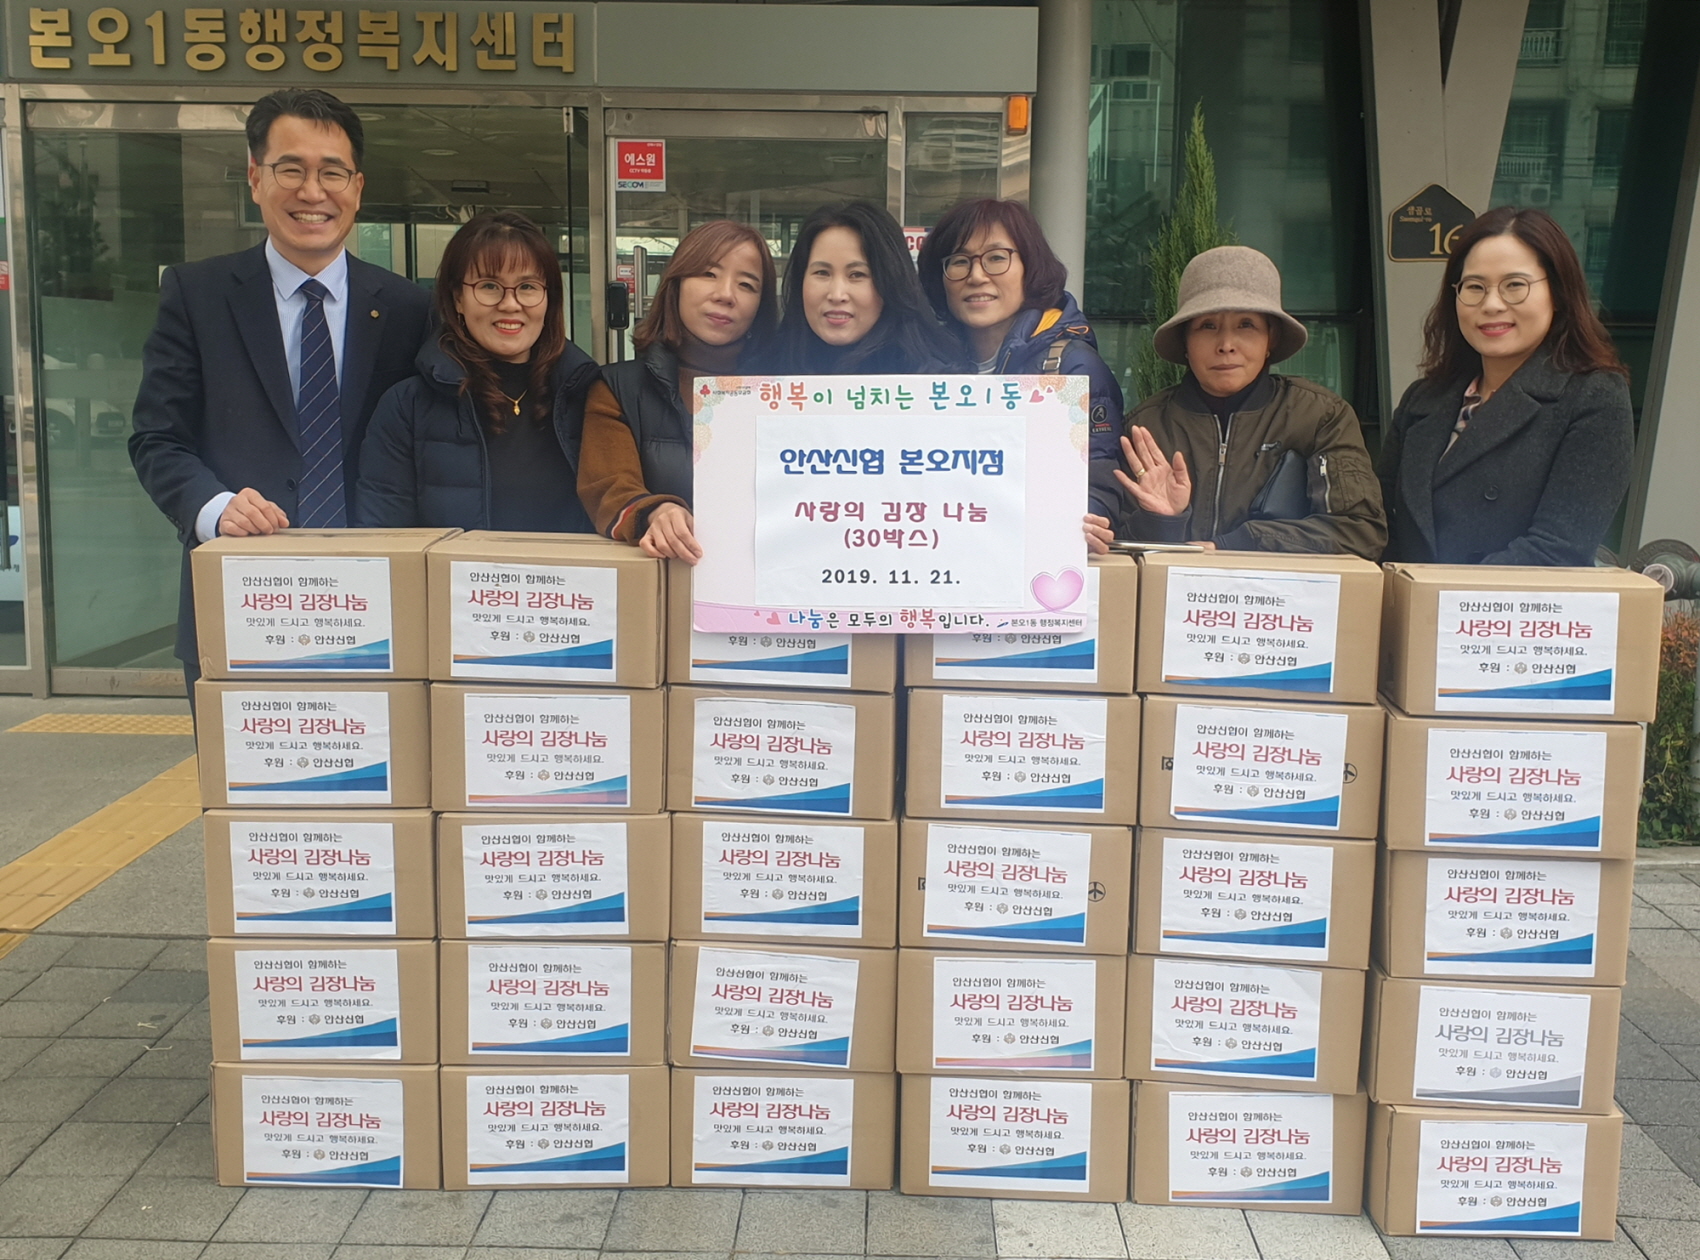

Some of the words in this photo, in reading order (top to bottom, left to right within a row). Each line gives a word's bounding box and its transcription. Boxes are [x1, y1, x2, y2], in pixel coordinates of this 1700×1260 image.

[624, 153, 656, 166] 에스원
[759, 381, 832, 412] 행복이
[847, 385, 914, 410] 넘치는
[929, 382, 1022, 410] 본오1동
[780, 448, 884, 475] 안산신협
[899, 449, 1003, 475] 본오지점
[795, 502, 864, 522] 사랑의
[881, 502, 927, 522] 김장
[944, 502, 987, 522] 나눔
[844, 528, 938, 549] (30박스)
[241, 577, 292, 587] 안산신협이
[298, 577, 339, 587] 함께하는
[469, 573, 520, 584] 안산신협이
[526, 575, 566, 586] 함께하는
[822, 569, 876, 584] 2019.
[889, 570, 918, 584] 11.
[930, 570, 960, 584] 21.
[240, 594, 292, 610] 사랑의
[299, 594, 368, 611] 김장나눔
[467, 589, 519, 608] 사랑의
[526, 592, 594, 610] 김장나눔
[1186, 593, 1238, 605] 안산신협이
[1244, 595, 1286, 607] 함께하는
[1459, 602, 1514, 613] 안산신협이
[1519, 603, 1563, 613] 함께하는
[788, 610, 839, 629] 나눔은
[848, 613, 892, 627] 모두의
[900, 610, 990, 629] 행복입니다.
[1011, 619, 1037, 627] 본오1동
[1040, 619, 1082, 627] 행정복지센터
[1182, 609, 1236, 628] 사랑의
[1244, 613, 1314, 632] 김장나눔
[1455, 620, 1511, 638] 사랑의
[1519, 620, 1593, 638] 김장나눔
[728, 635, 748, 646] 후원
[776, 638, 816, 649] 안산신협
[972, 633, 992, 643] 후원
[1021, 634, 1062, 644] 안산신협
[241, 702, 291, 711] 안산신협이
[297, 702, 337, 711] 함께하는
[240, 718, 291, 734] 사랑의
[298, 718, 366, 734] 김장나눔
[713, 717, 762, 728] 안산신협이
[767, 719, 806, 730] 함께하는
[482, 730, 533, 747] 사랑의
[540, 730, 608, 747] 김장나눔
[960, 730, 1011, 748] 사랑의
[1018, 732, 1085, 750] 김장나눔
[1196, 724, 1248, 737] 안산신협이
[1253, 728, 1295, 740] 함께하는
[710, 733, 760, 751] 사랑의
[767, 736, 833, 755] 김장나눔
[554, 755, 604, 763] 행복하세요.
[965, 754, 993, 763] 맛있게
[998, 755, 1026, 764] 드시고
[1031, 756, 1081, 766] 행복하세요.
[1192, 741, 1245, 761] 사랑의
[1253, 746, 1322, 766] 김장나눔
[1446, 766, 1501, 784] 사랑의
[1509, 768, 1582, 786] 김장나눔
[1451, 791, 1481, 800] 맛있게
[1487, 792, 1517, 800] 드시고
[1523, 793, 1576, 803] 행복하세요.
[481, 835, 531, 845] 안산신협이
[536, 834, 576, 844] 함께하는
[247, 849, 298, 865] 사랑의
[304, 849, 371, 865] 김장나눔
[479, 851, 530, 868] 사랑의
[537, 849, 604, 867] 김장나눔
[718, 849, 768, 866] 사랑의
[775, 850, 841, 868] 김장나눔
[947, 844, 996, 856] 안산신협이
[1002, 847, 1041, 859] 함께하는
[319, 873, 368, 881] 행복하세요.
[723, 872, 751, 880] 맛있게
[756, 873, 783, 881] 드시고
[788, 874, 837, 884] 행복하세요.
[943, 860, 994, 879] 사랑의
[1001, 864, 1068, 884] 김장나눔
[1179, 866, 1231, 885] 사랑의
[1239, 869, 1308, 889] 김장나눔
[1447, 870, 1500, 880] 안산신협이
[1505, 871, 1547, 881] 함께하는
[1184, 890, 1213, 899] 맛있게
[1218, 892, 1246, 901] 드시고
[1252, 894, 1303, 905] 행복하세요.
[1444, 886, 1497, 904] 사랑의
[1505, 888, 1575, 905] 김장나눔
[253, 960, 302, 970] 안산신협이
[308, 960, 347, 969] 함께하는
[253, 976, 303, 992] 사랑의
[309, 975, 376, 992] 김장나눔
[715, 968, 764, 980] 안산신협이
[769, 972, 808, 984] 함께하는
[486, 979, 536, 996] 사랑의
[543, 980, 610, 996] 김장나눔
[1174, 980, 1224, 992] 안산신협이
[1230, 983, 1270, 994] 함께하는
[711, 983, 761, 1002] 사랑의
[769, 988, 834, 1008] 김장나눔
[950, 994, 1000, 1010] 사랑의
[1007, 994, 1073, 1012] 김장나눔
[557, 1003, 606, 1012] 행복하세요.
[1170, 996, 1222, 1014] 사랑의
[1229, 1000, 1298, 1019] 김장나눔
[1020, 1018, 1069, 1027] 행복하세요.
[1434, 1024, 1488, 1043] 사랑의
[1496, 1028, 1564, 1047] 김장나눔
[1439, 1049, 1468, 1058] 맛있게
[1474, 1050, 1502, 1059] 드시고
[1508, 1052, 1559, 1063] 행복하세요.
[485, 1085, 534, 1095] 안산신협이
[540, 1085, 579, 1094] 함께하는
[949, 1088, 998, 1099] 안산신협이
[1003, 1090, 1042, 1101] 함께하는
[261, 1095, 310, 1105] 안산신협이
[315, 1096, 354, 1106] 함께하는
[483, 1101, 533, 1117] 사랑의
[540, 1100, 606, 1117] 김장나눔
[709, 1102, 759, 1118] 사랑의
[766, 1103, 831, 1120] 김장나눔
[946, 1104, 996, 1122] 사랑의
[1003, 1106, 1069, 1124] 김장나눔
[259, 1110, 309, 1127] 사랑의
[315, 1112, 381, 1129] 김장나눔
[1185, 1128, 1236, 1144] 사랑의
[1243, 1128, 1311, 1144] 김장나눔
[1440, 1140, 1490, 1150] 안산신협이
[1495, 1140, 1536, 1150] 함께하는
[1436, 1156, 1488, 1173] 사랑의
[1495, 1157, 1563, 1173] 김장나눔
